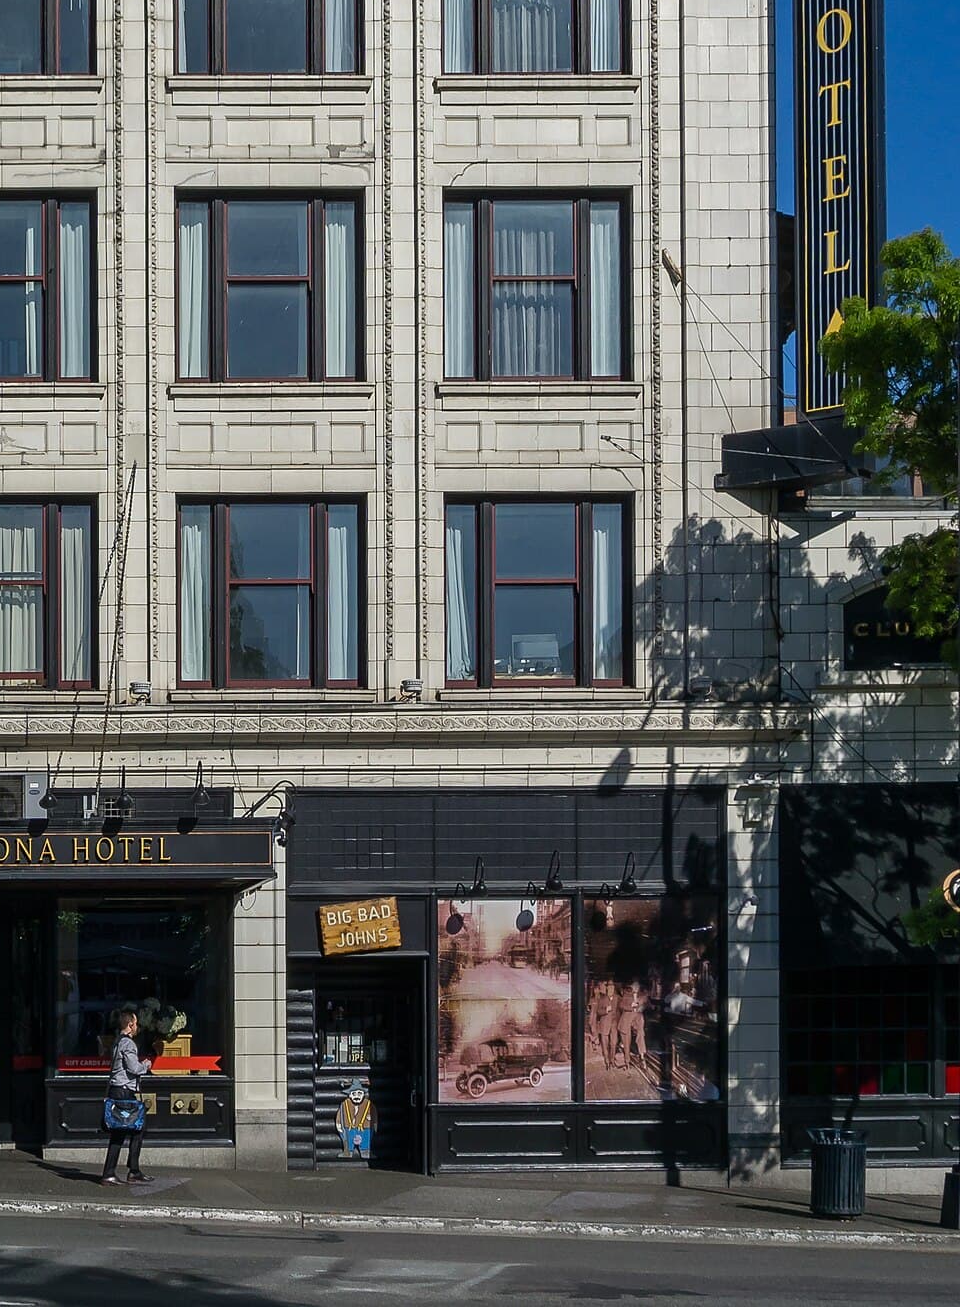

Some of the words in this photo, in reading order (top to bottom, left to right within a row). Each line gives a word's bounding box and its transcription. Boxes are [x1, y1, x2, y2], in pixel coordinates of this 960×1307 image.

[854, 622, 910, 637] CLU
[73, 837, 171, 862] HOTEL
[327, 910, 352, 925] BIG
[358, 905, 391, 921] BAD
[336, 927, 388, 947] JOHNS
